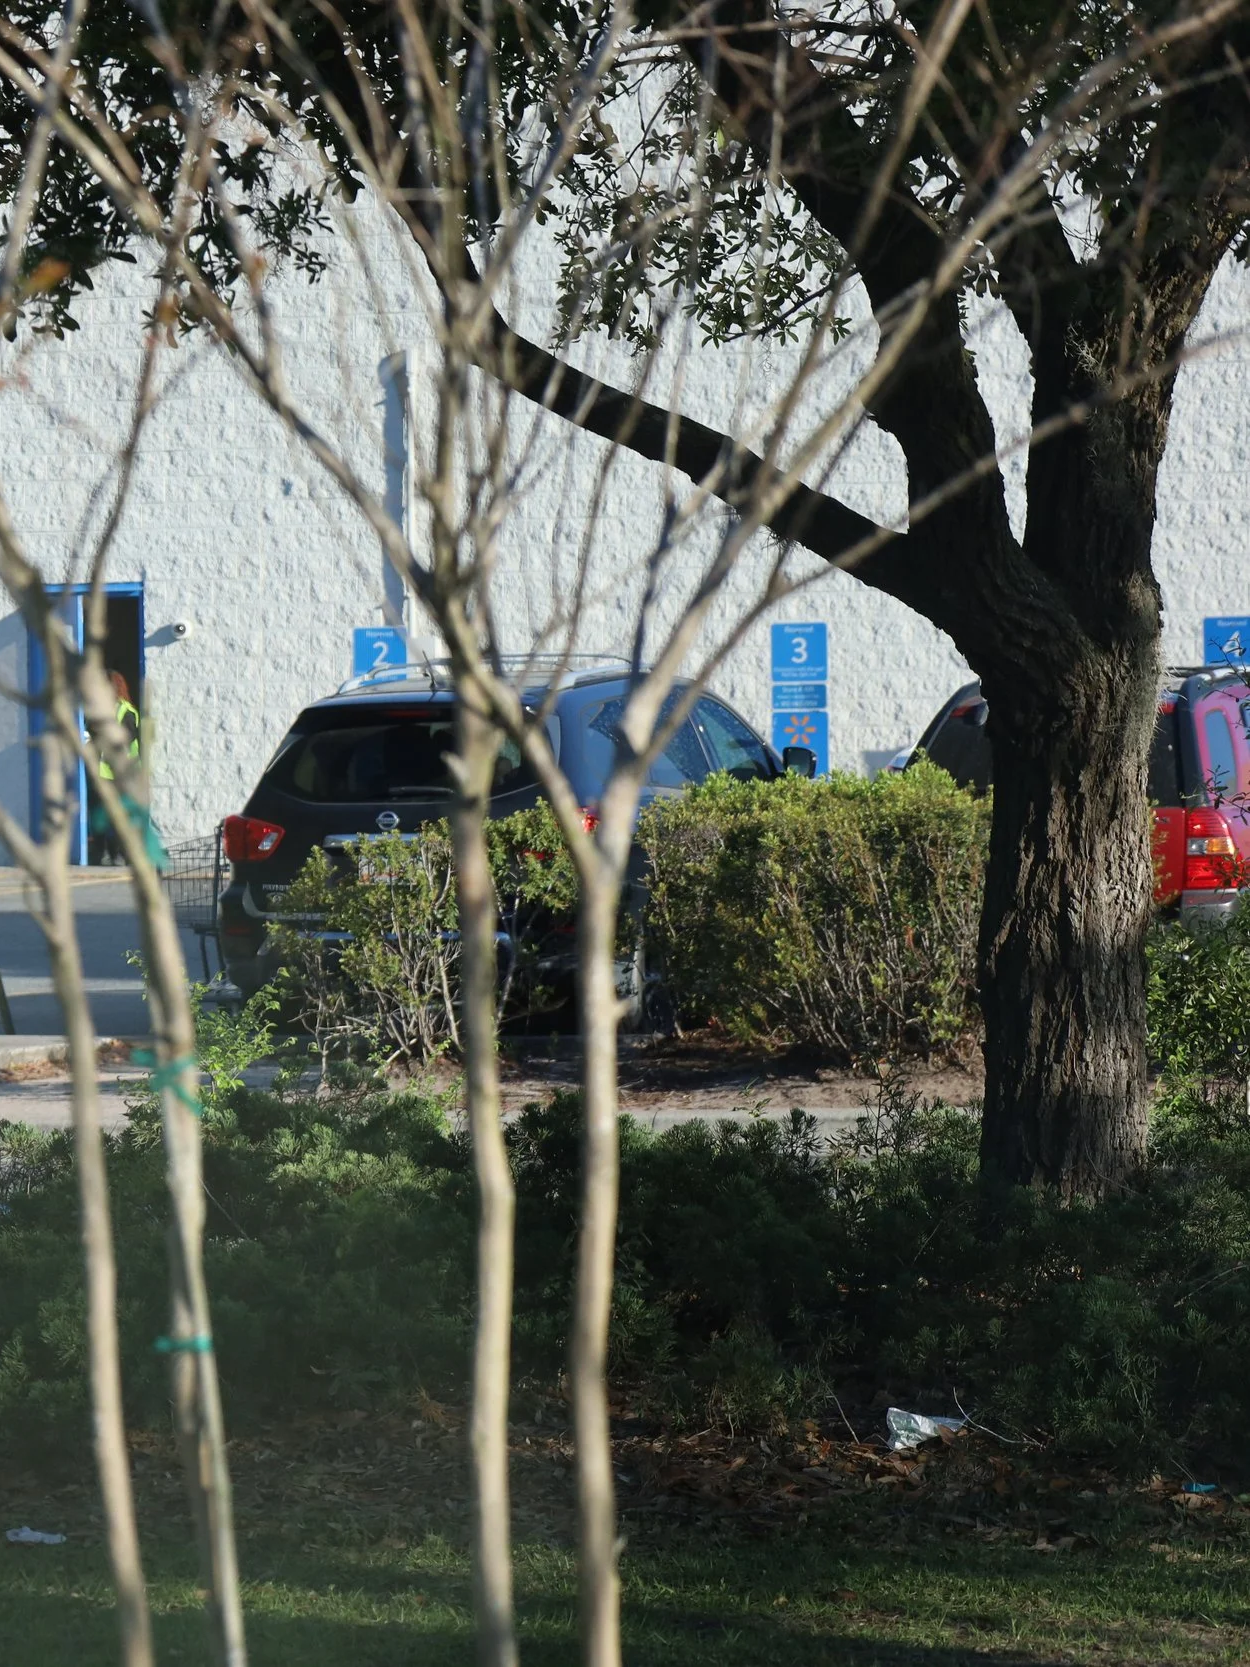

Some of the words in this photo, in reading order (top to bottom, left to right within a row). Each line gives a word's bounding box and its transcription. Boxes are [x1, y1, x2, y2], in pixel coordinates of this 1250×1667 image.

[372, 641, 392, 668] 2
[791, 636, 808, 664] 3
[1222, 630, 1244, 657] 4
